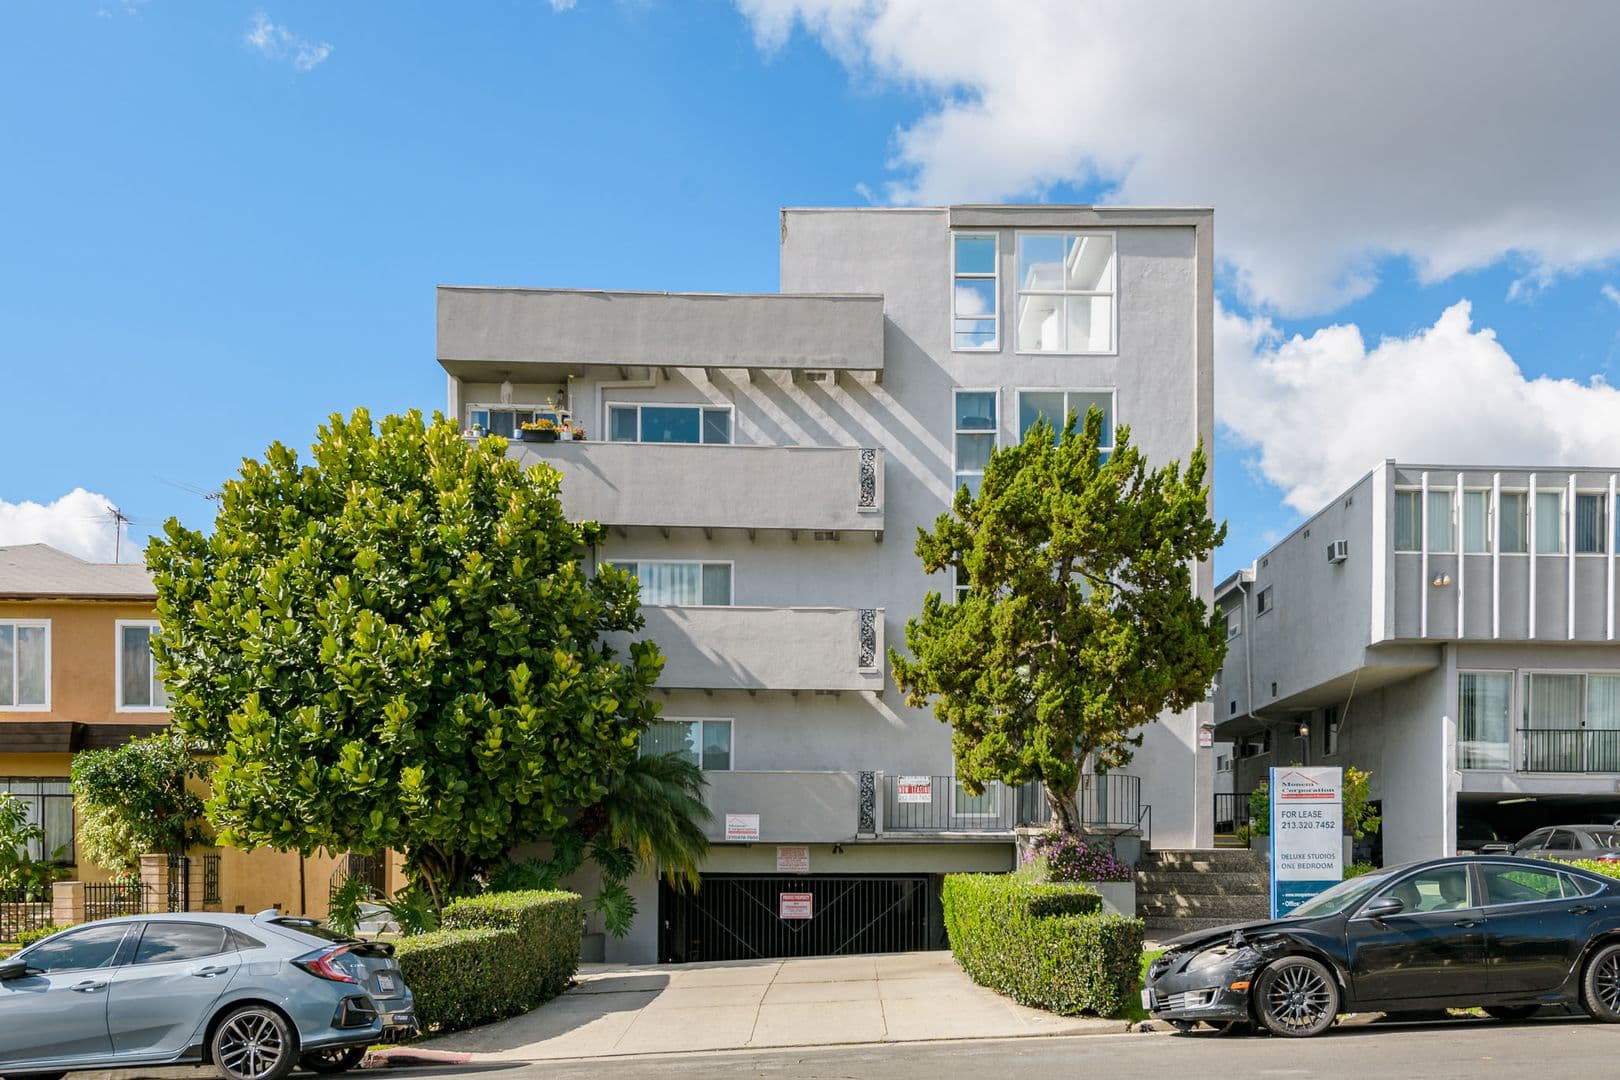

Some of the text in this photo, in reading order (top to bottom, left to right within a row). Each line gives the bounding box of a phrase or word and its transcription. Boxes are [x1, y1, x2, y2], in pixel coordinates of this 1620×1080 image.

[1281, 810, 1323, 818] FOR LEASE
[1281, 821, 1336, 829] 213.320.7452
